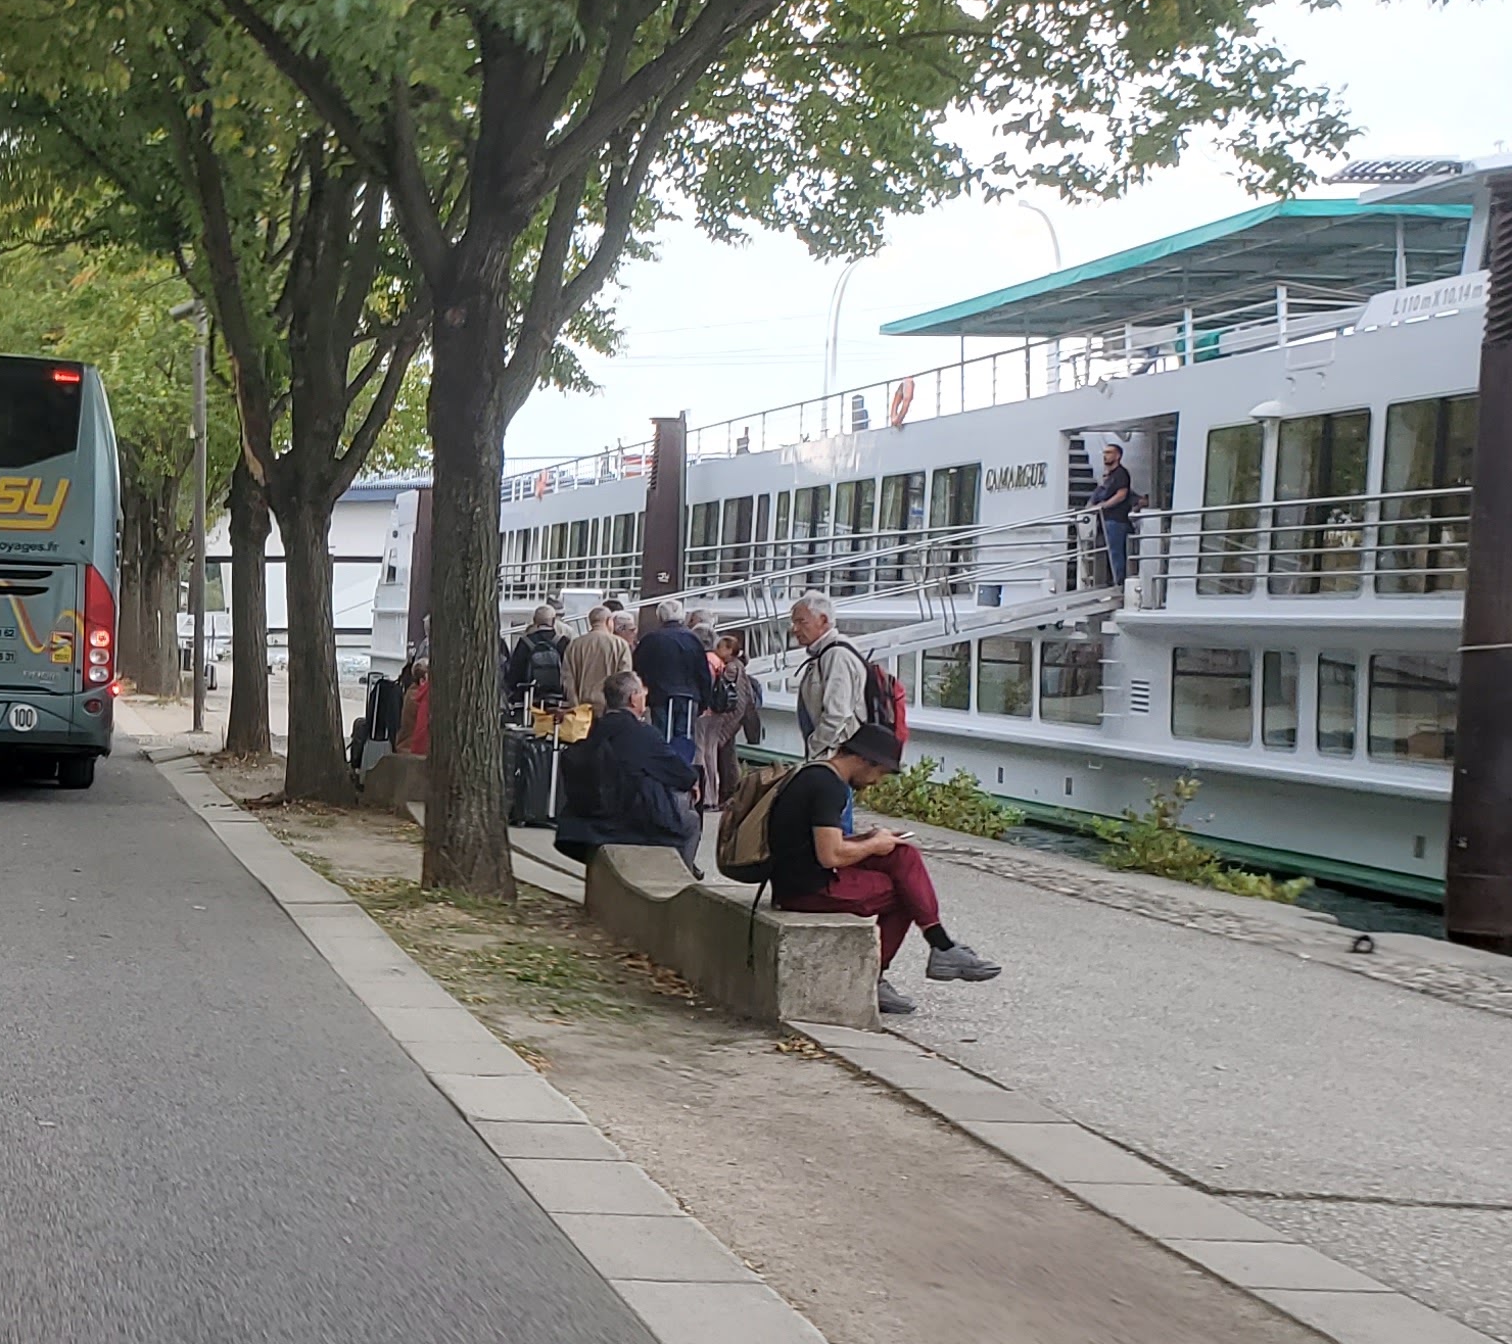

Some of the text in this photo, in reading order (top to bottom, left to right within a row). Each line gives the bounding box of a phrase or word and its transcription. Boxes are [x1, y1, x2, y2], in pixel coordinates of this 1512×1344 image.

[986, 462, 1048, 492] CAMARGUE
[4, 629, 15, 637] 62
[5, 652, 14, 661] 31
[14, 708, 33, 728] 100
